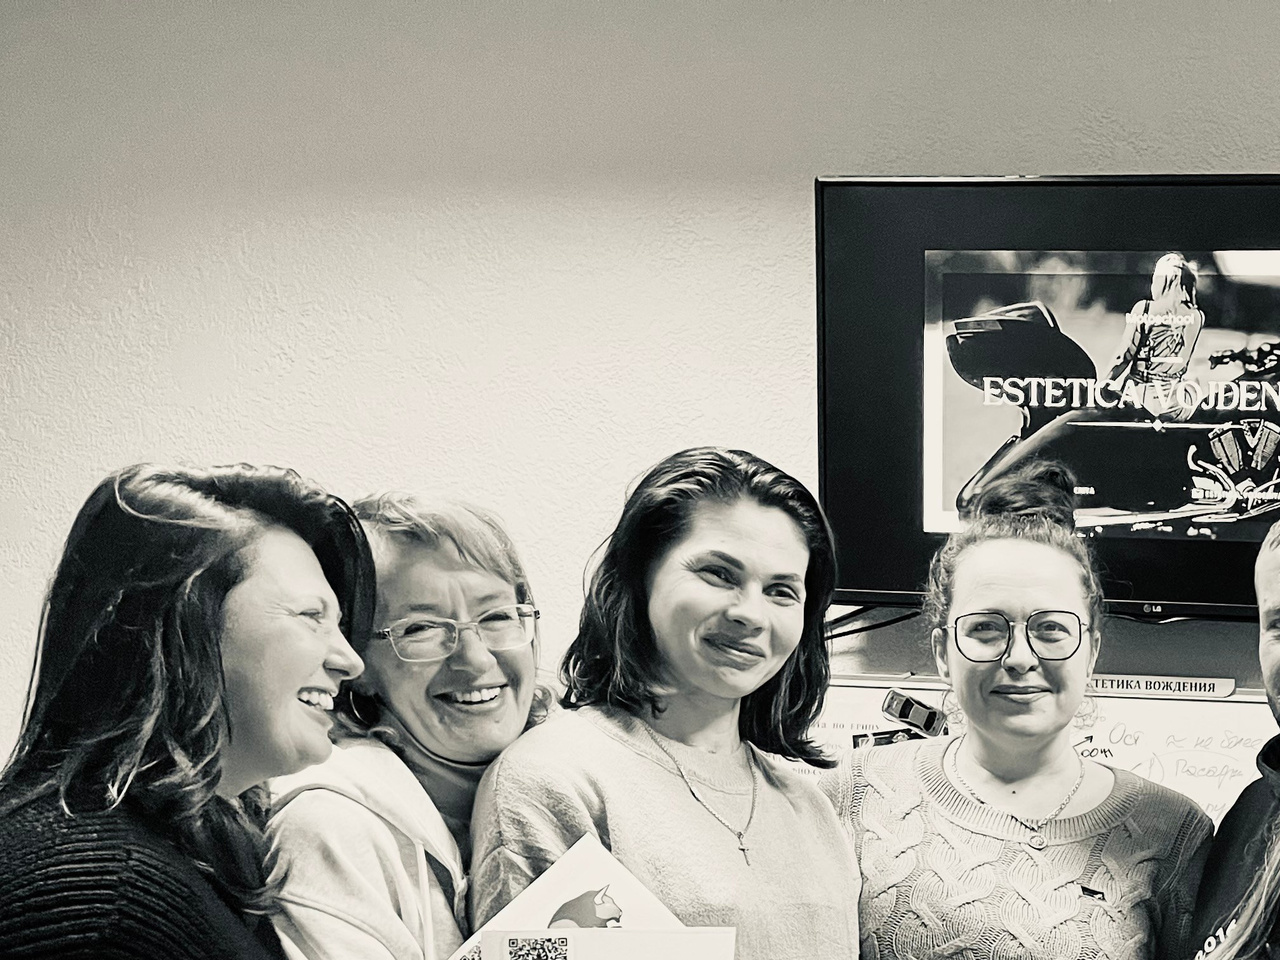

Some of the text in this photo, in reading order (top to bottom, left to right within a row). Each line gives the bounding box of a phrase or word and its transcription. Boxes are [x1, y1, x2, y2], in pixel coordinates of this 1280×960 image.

[983, 376, 1142, 410] ESTETICA
[1095, 679, 1216, 692] ТЕТИКА ВОЖДЕНИЯ
